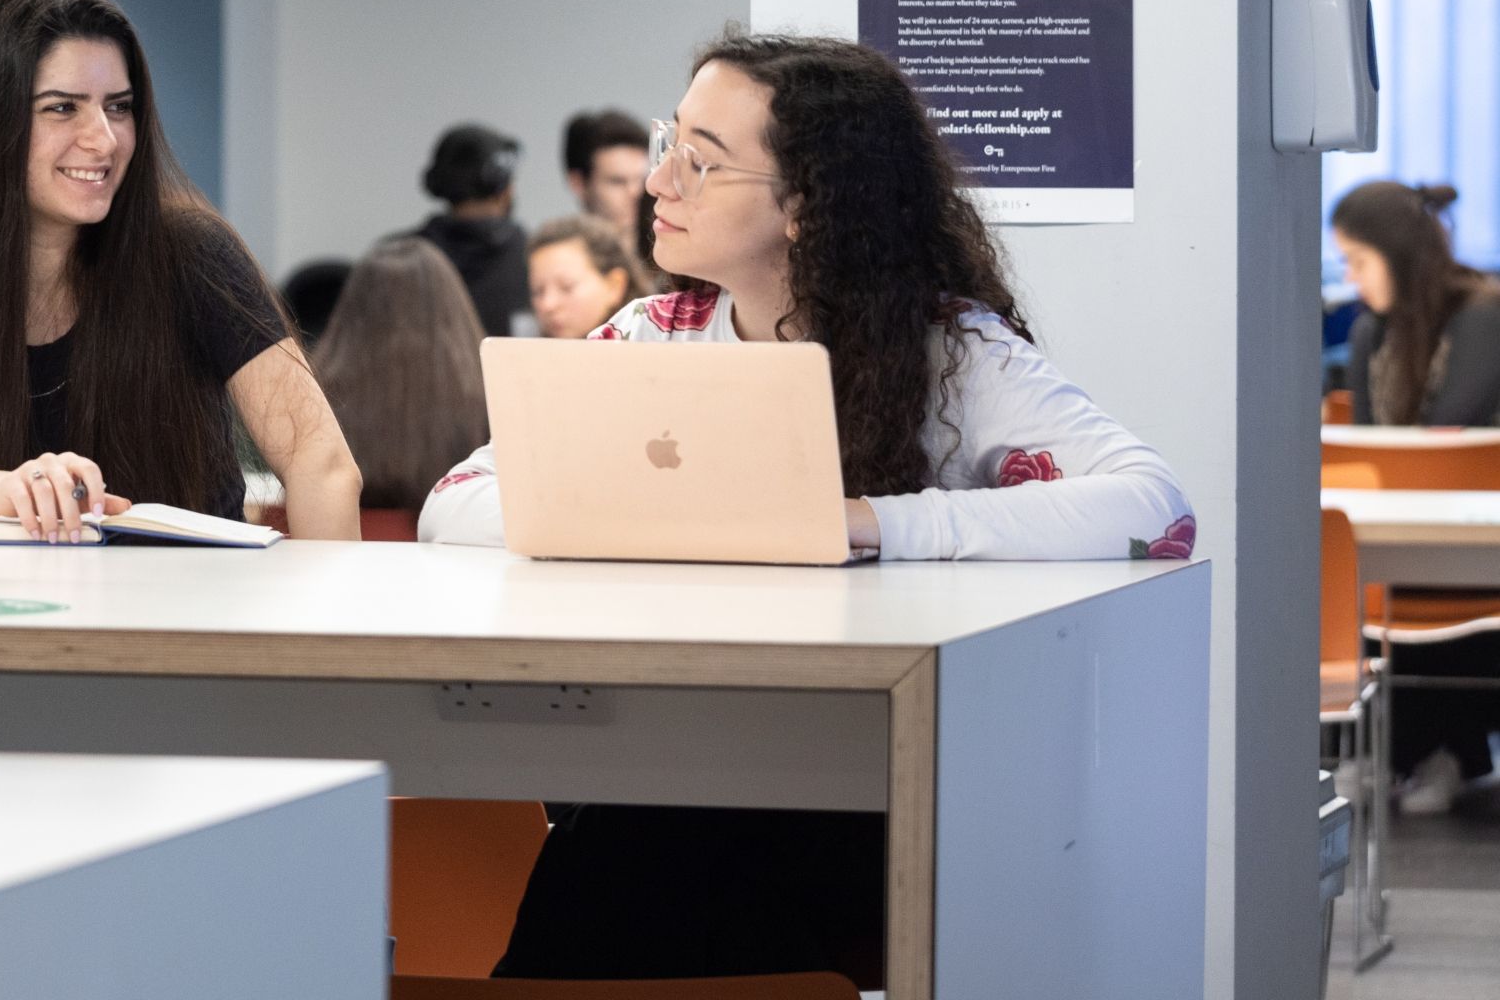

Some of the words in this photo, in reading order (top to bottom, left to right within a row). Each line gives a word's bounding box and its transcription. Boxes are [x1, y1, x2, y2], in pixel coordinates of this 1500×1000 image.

[898, 0, 925, 8] interests,
[975, 0, 988, 8] they
[898, 16, 911, 24] You
[912, 16, 924, 24] will
[924, 16, 937, 26] join
[942, 16, 963, 24] cohort
[964, 16, 971, 24] of
[972, 16, 980, 24] 24
[981, 16, 1000, 26] smart,
[1001, 16, 1025, 26] earnest,
[1026, 16, 1038, 24] and
[1039, 16, 1090, 26] high-expectation
[898, 27, 932, 35] individuals
[932, 27, 962, 35] interested
[963, 27, 970, 35] in
[971, 27, 986, 35] both
[988, 27, 997, 35] the
[999, 27, 1023, 37] mastery
[1024, 27, 1031, 35] of
[1032, 27, 1042, 35] the
[1043, 27, 1076, 35] established
[1078, 27, 1090, 35] and
[898, 38, 908, 46] the
[909, 38, 937, 48] discovery
[938, 38, 946, 46] of
[946, 38, 956, 46] the
[957, 38, 984, 46] heretical.
[906, 58, 922, 66] years
[922, 56, 930, 64] of
[930, 56, 954, 66] backing
[955, 56, 988, 64] individuals
[989, 56, 1009, 64] before
[1009, 56, 1022, 66] they
[1023, 56, 1038, 64] have
[1043, 56, 1057, 64] track
[1059, 56, 1078, 64] record
[1079, 56, 1090, 64] has
[927, 66, 934, 74] to
[934, 66, 948, 74] take
[948, 68, 960, 76] you
[961, 66, 973, 74] and
[974, 68, 988, 76] your
[989, 66, 1016, 76] potential
[1017, 66, 1044, 76] seriously.
[926, 107, 949, 118] Find
[952, 107, 969, 118] out
[972, 110, 997, 118] more
[1000, 107, 1019, 118] and
[1021, 107, 1049, 121] apply
[1052, 107, 1062, 118] at
[991, 164, 999, 174] by
[1001, 164, 1040, 174] Entrepreneur
[1042, 164, 1056, 172] First
